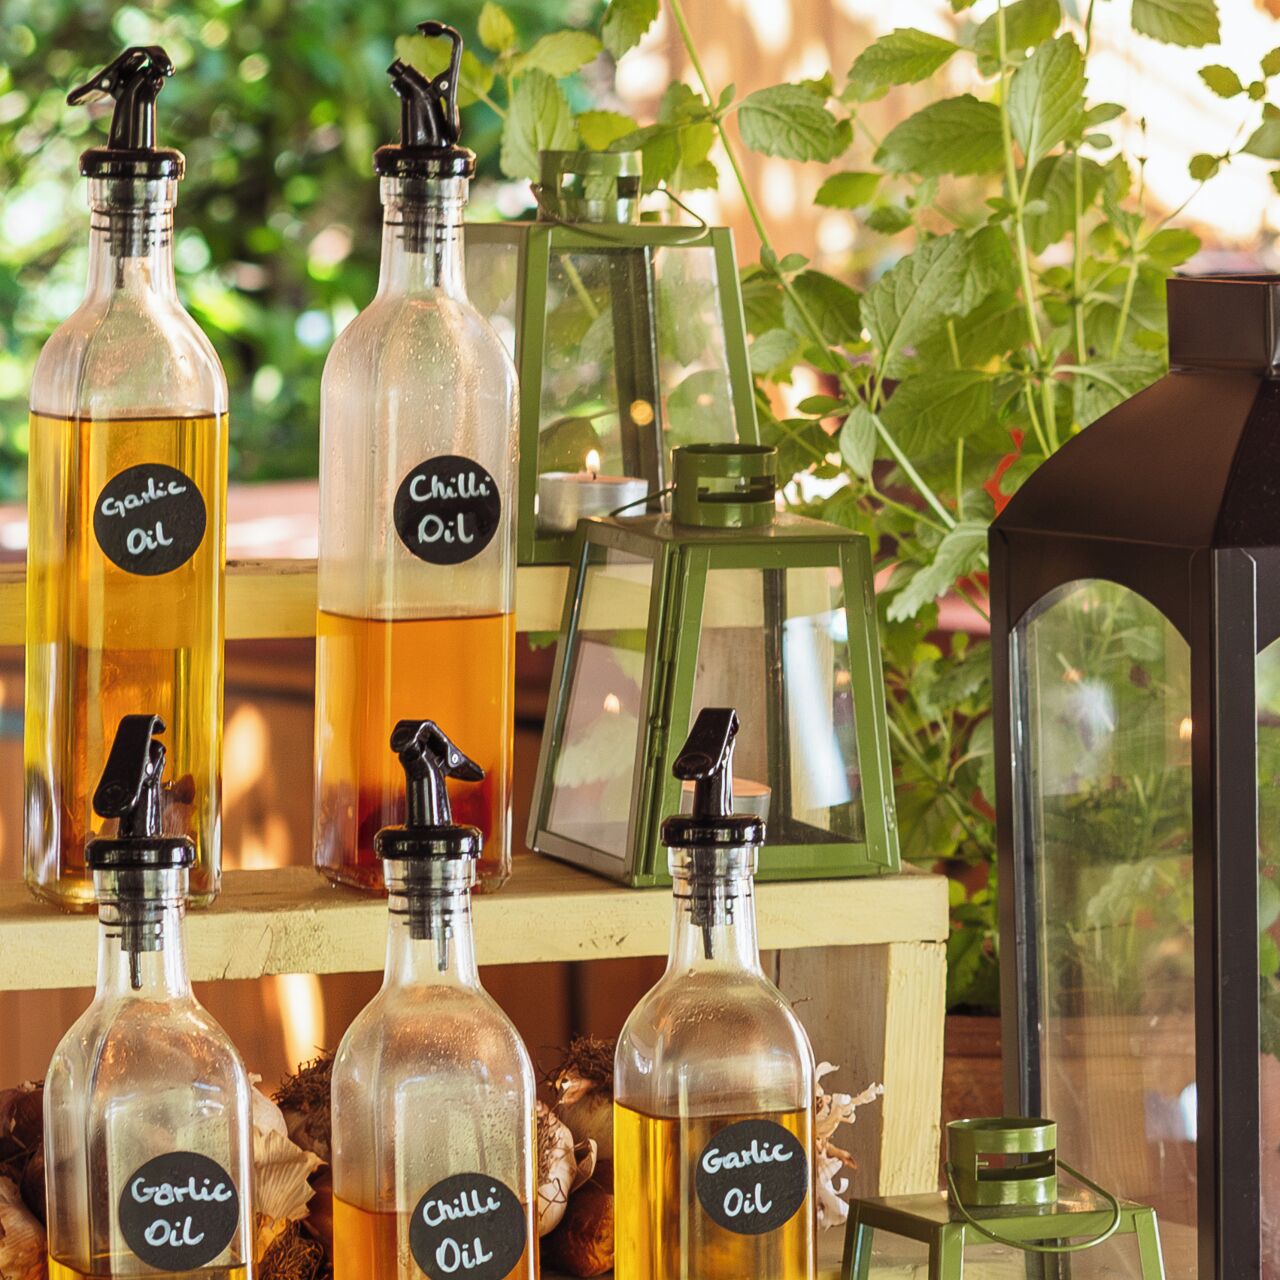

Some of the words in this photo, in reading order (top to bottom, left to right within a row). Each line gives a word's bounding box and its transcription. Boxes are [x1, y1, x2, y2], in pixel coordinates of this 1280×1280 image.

[409, 472, 492, 501] Chilli
[127, 521, 173, 554] Oil
[418, 513, 473, 543] Oil
[702, 1140, 793, 1174] Garlic
[132, 1175, 232, 1206] Garlic
[423, 1187, 500, 1226] Chilli
[724, 1183, 772, 1217] Oil
[144, 1216, 204, 1246] Oil
[436, 1237, 493, 1272] Oil
